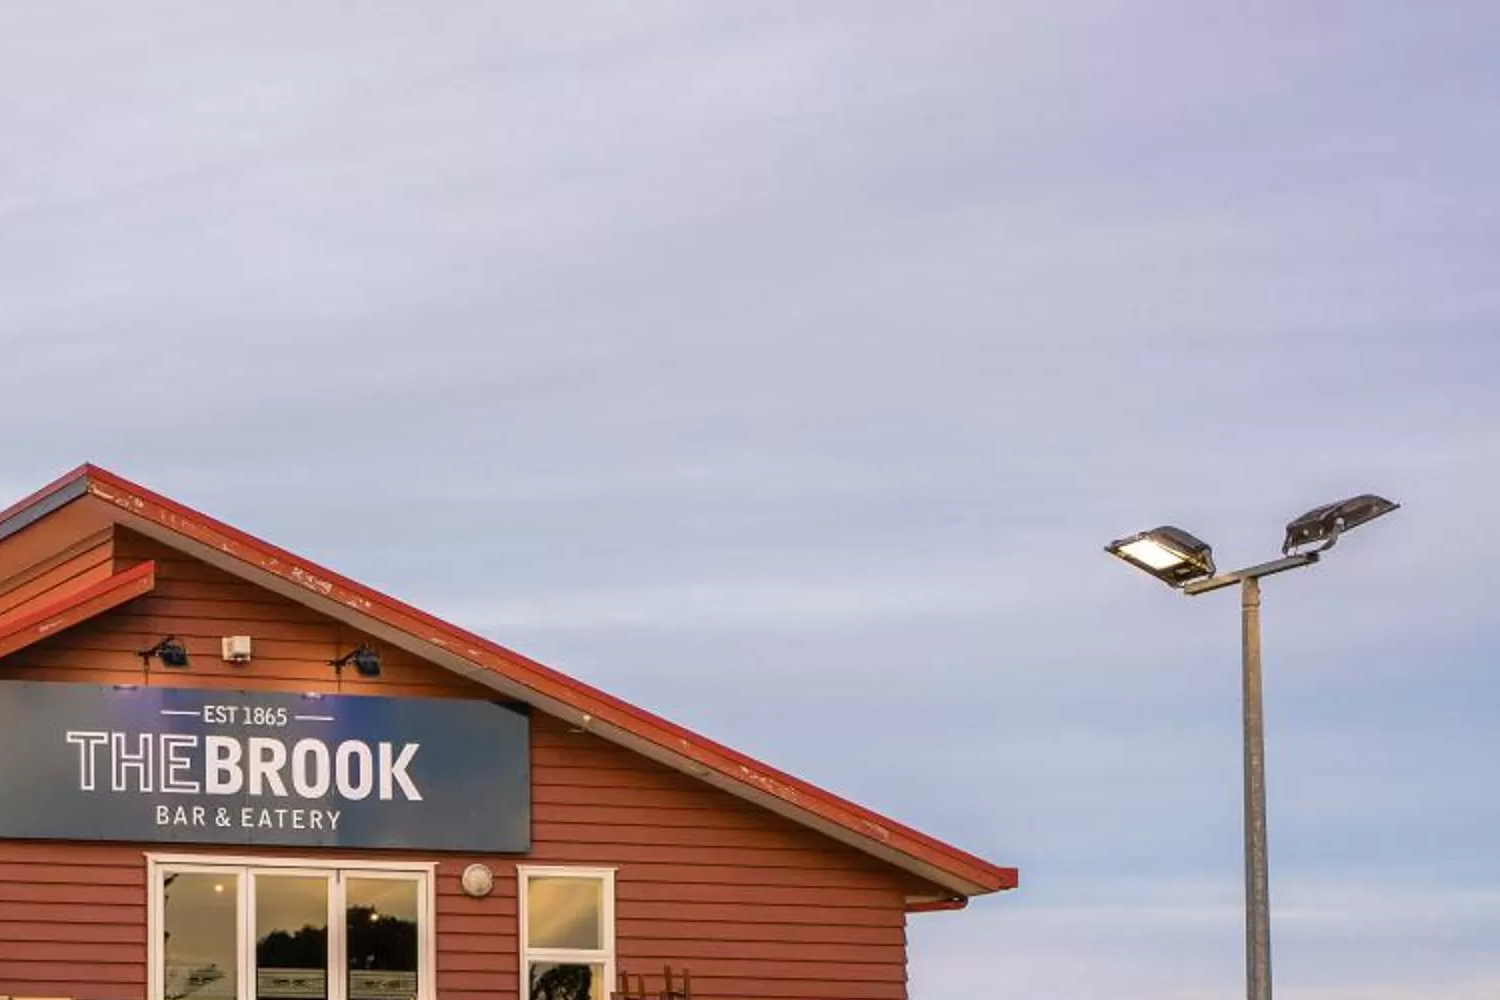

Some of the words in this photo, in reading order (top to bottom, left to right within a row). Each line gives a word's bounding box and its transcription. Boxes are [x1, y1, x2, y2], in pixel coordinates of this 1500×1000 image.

[203, 705, 238, 724] EST
[243, 707, 288, 726] 1865
[156, 805, 206, 826] BAR
[215, 808, 232, 827] &
[241, 807, 342, 830] EATERY
